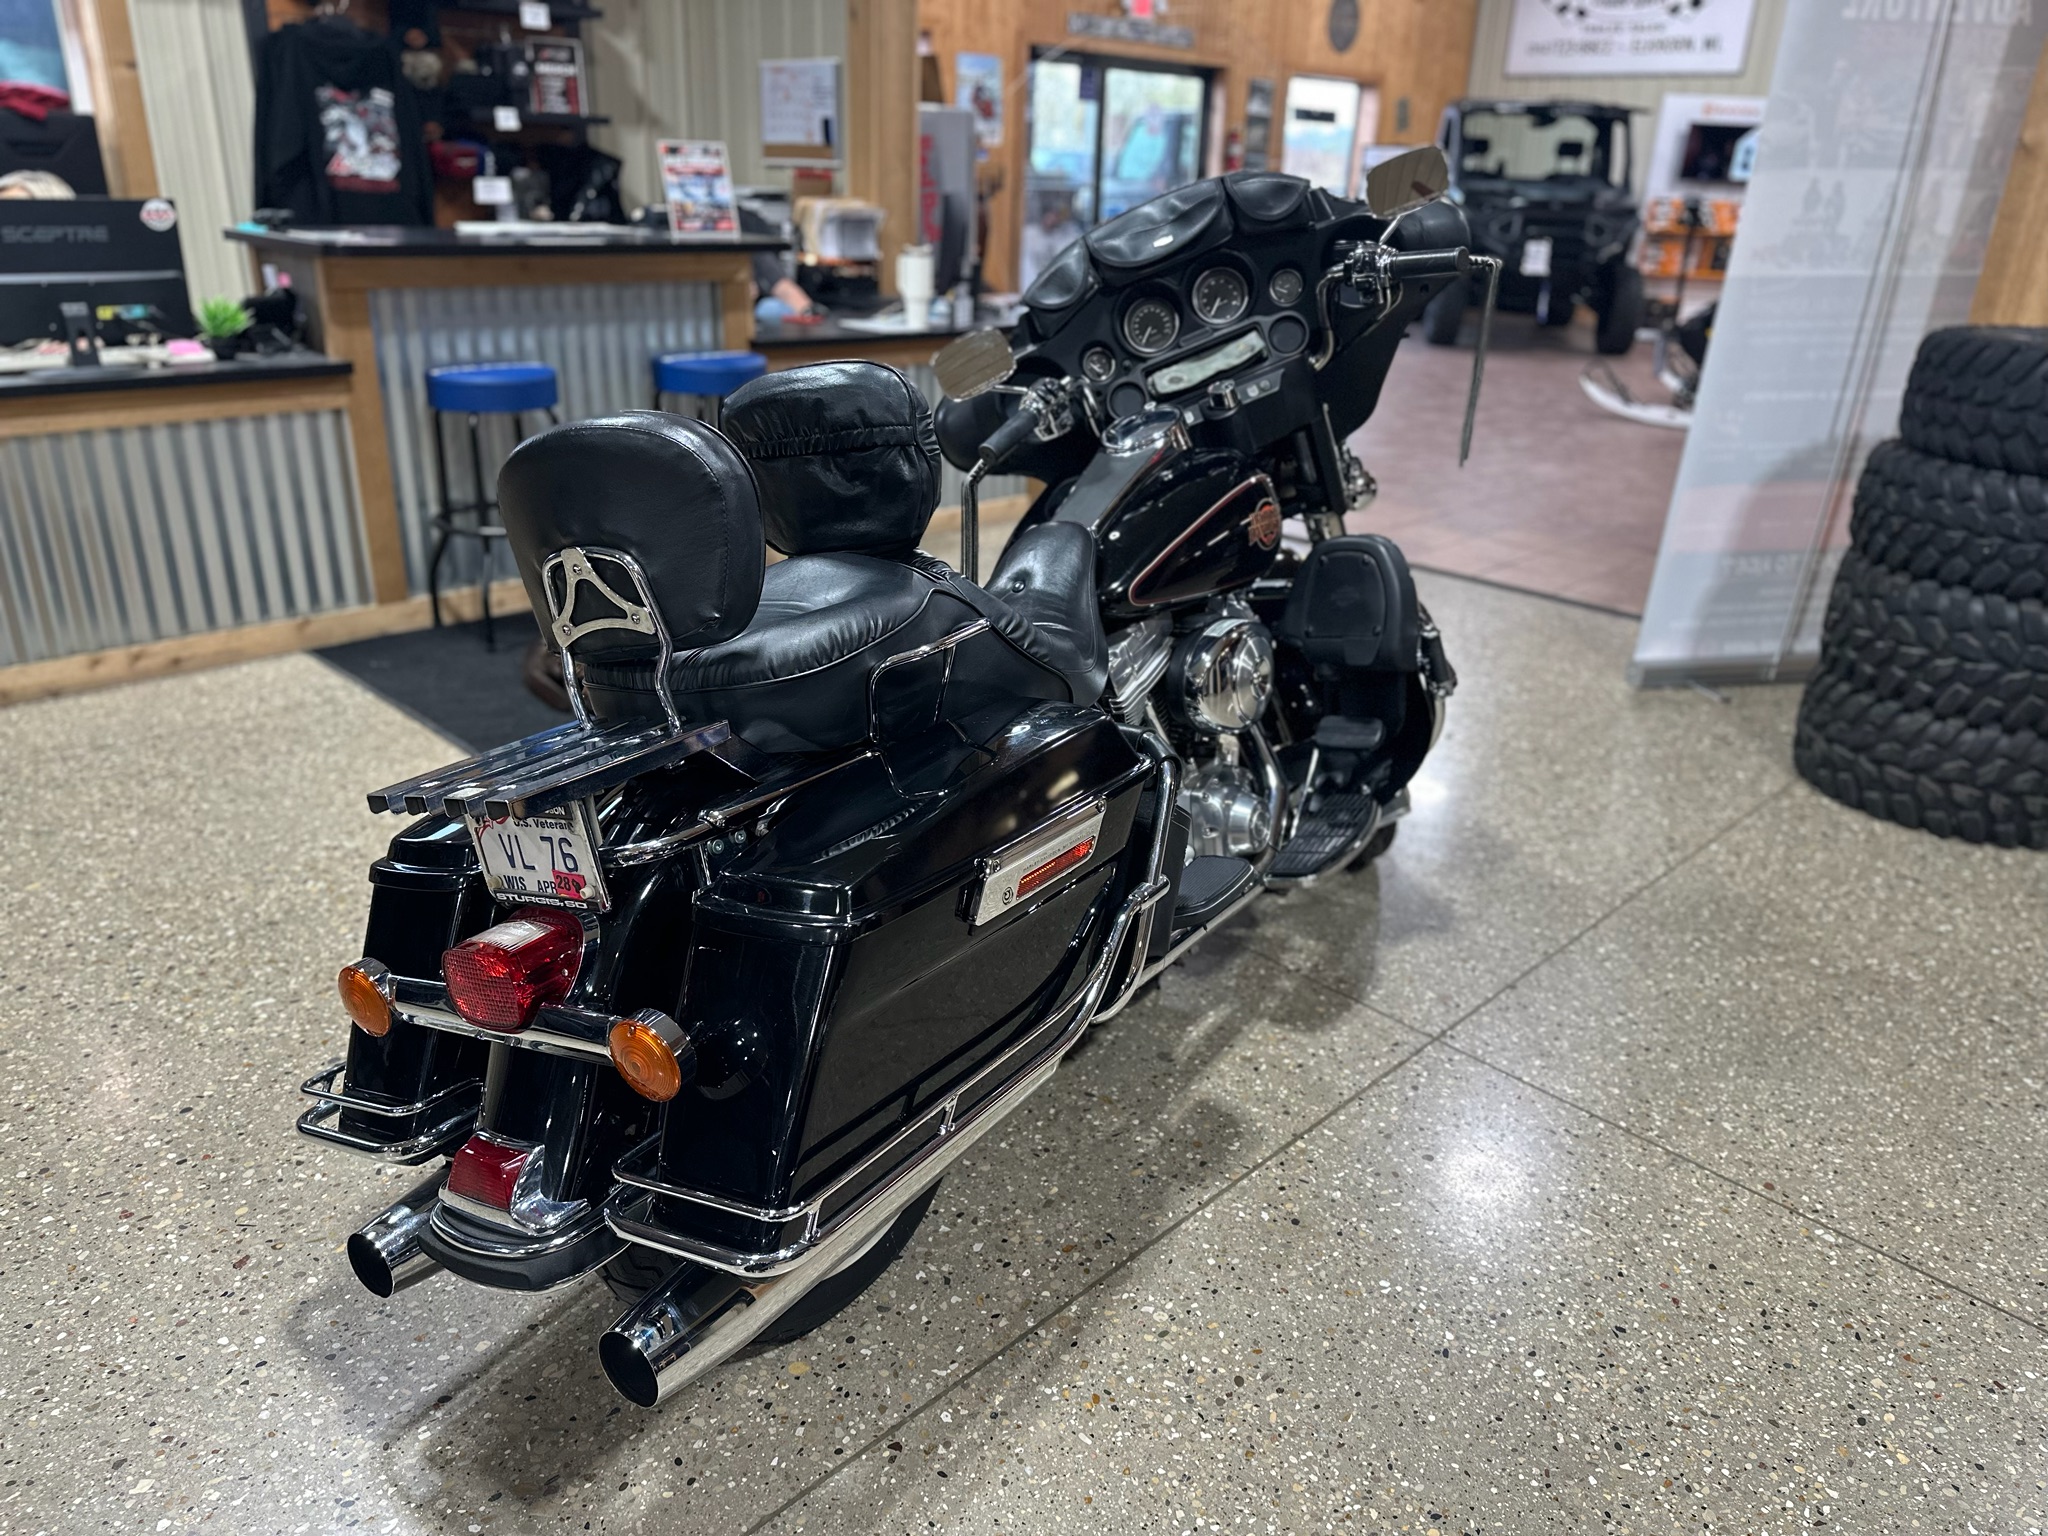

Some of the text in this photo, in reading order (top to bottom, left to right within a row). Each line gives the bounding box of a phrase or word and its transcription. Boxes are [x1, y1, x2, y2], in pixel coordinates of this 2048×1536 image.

[1, 224, 110, 243] SCEPTRE
[498, 834, 578, 873] VL 76
[503, 875, 558, 894] WIS APR
[565, 900, 588, 909] SD
